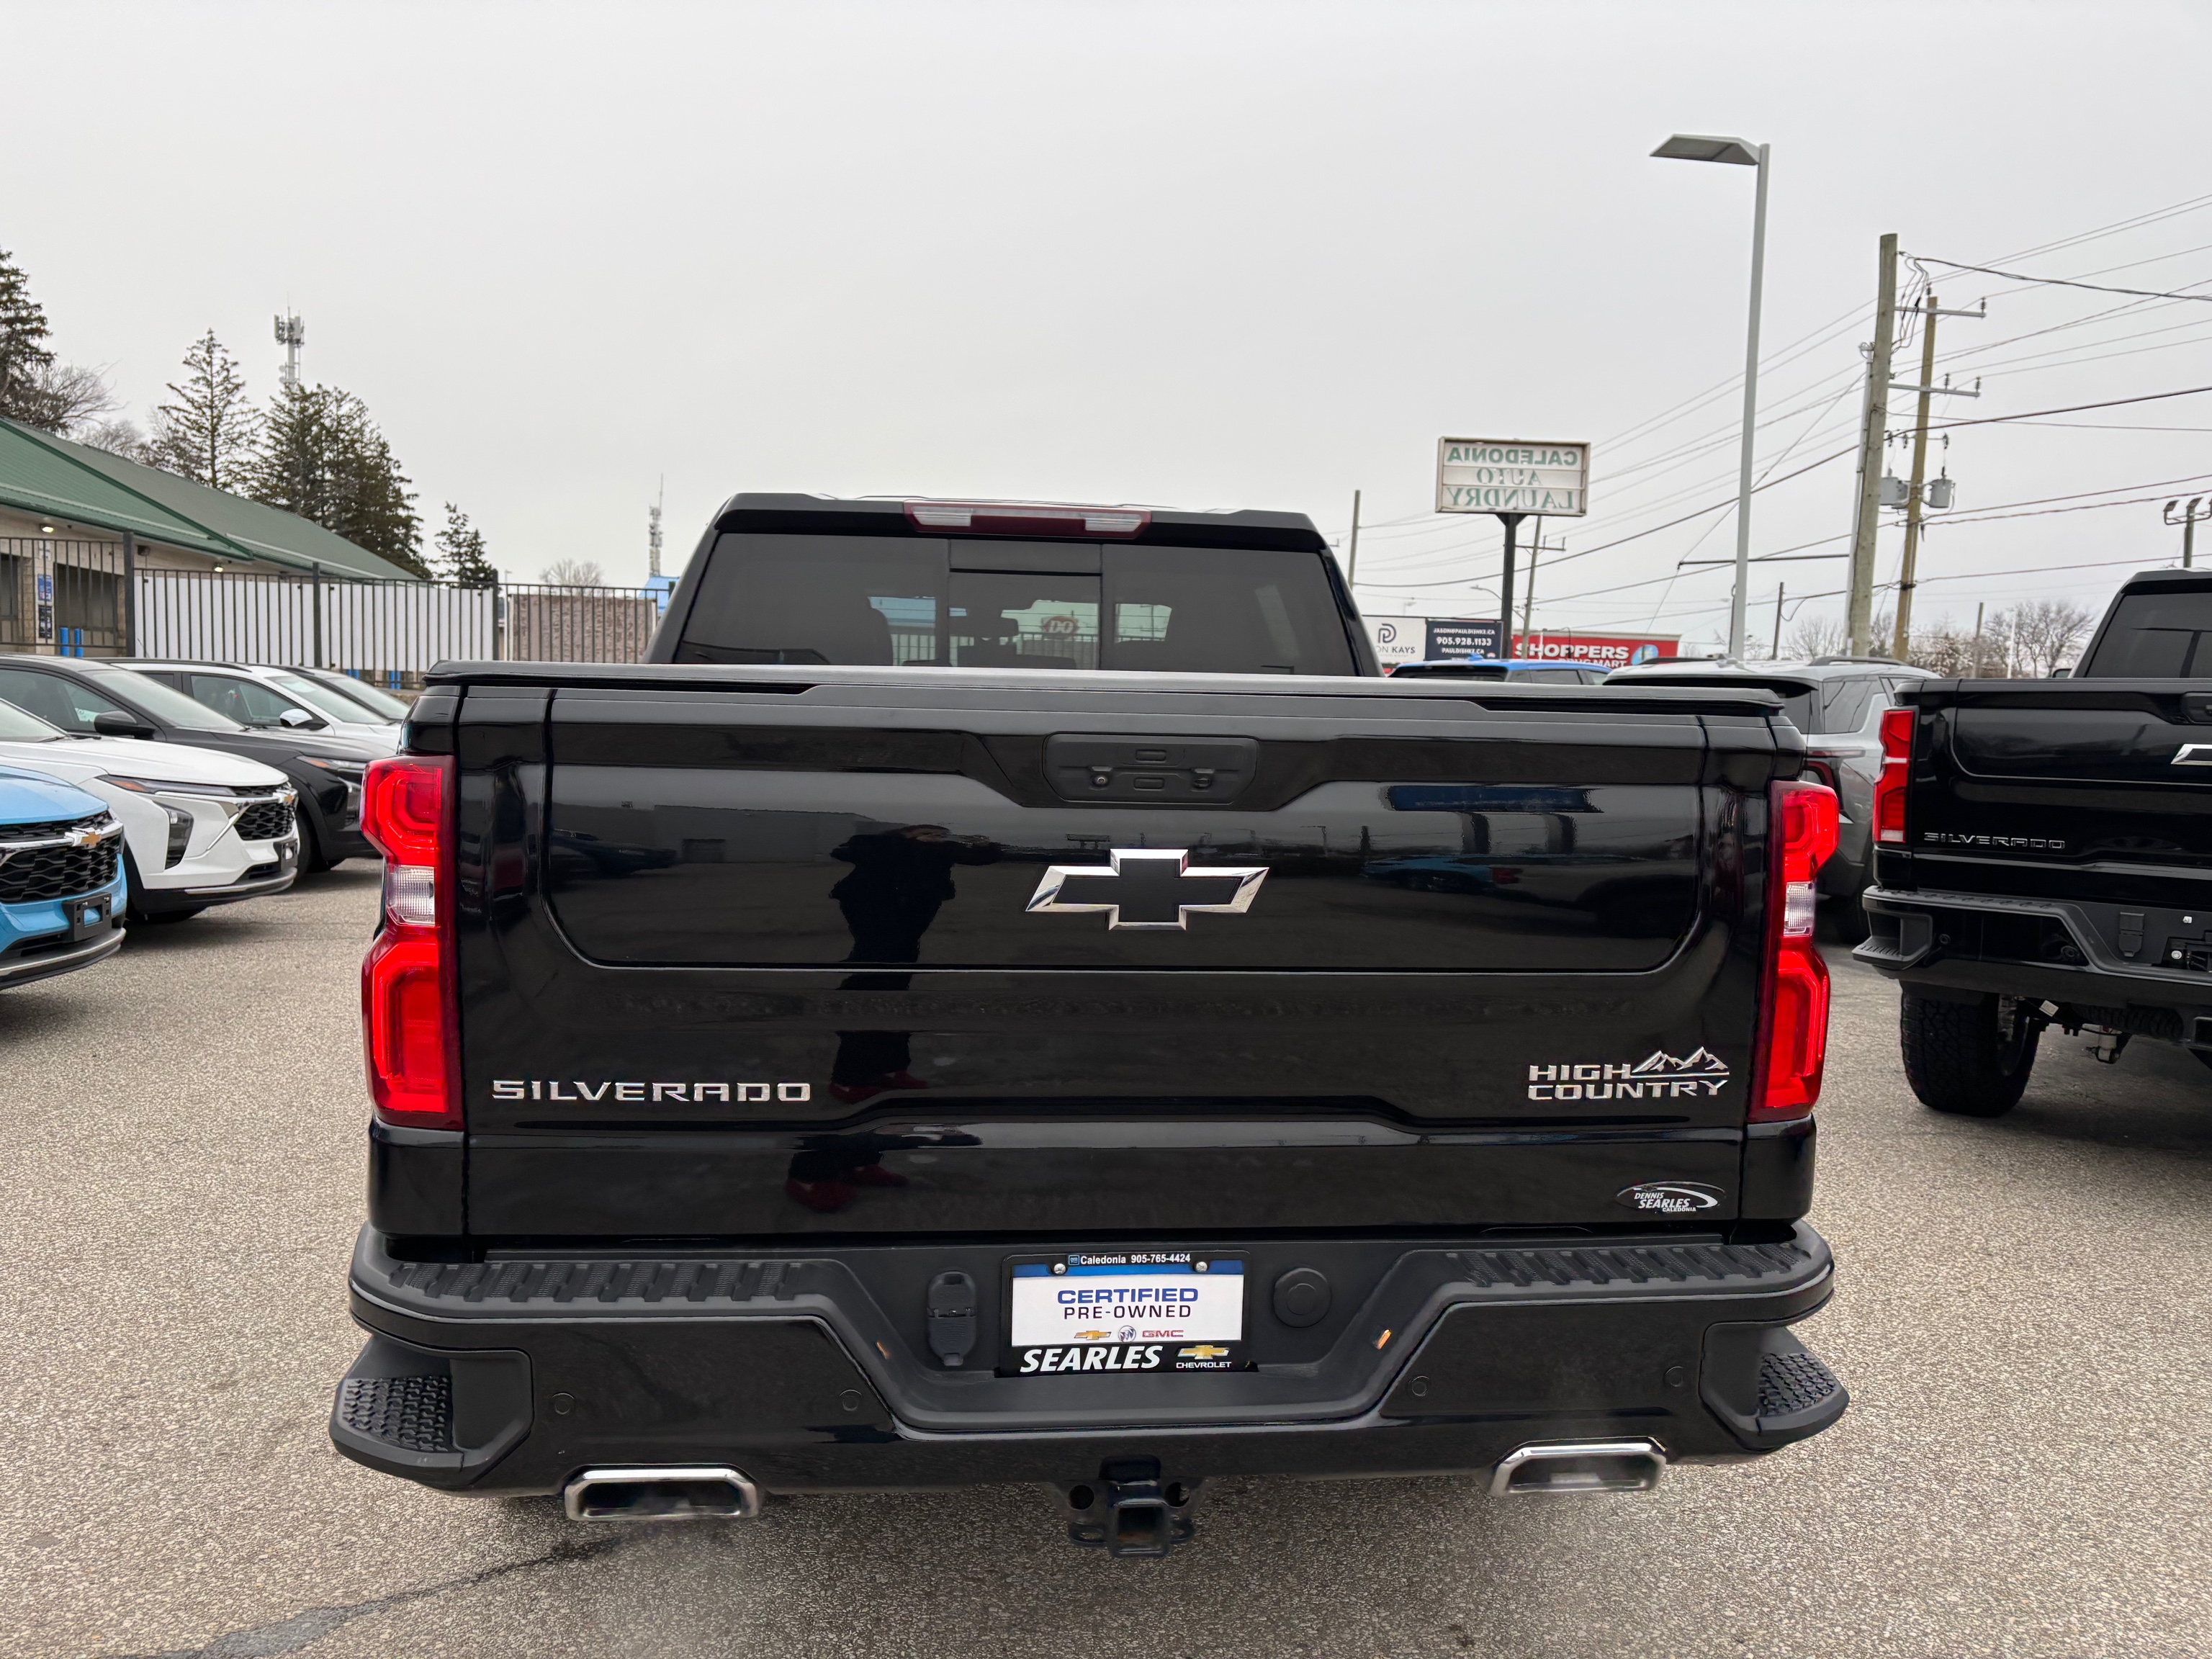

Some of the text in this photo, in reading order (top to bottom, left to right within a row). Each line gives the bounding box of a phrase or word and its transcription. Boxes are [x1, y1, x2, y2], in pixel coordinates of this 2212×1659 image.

[1436, 637, 1493, 647] 905.928.1133
[1515, 642, 1629, 659] SHOPPERS
[1592, 659, 1627, 668] MART
[1924, 832, 2065, 849] SILVERADO
[1529, 1064, 1632, 1081] HIGH
[492, 1080, 811, 1102] SILVERADO
[1528, 1080, 1728, 1100] COUNTRY
[1638, 1198, 1691, 1209] SEARLES
[1080, 1255, 1126, 1265] Caledonia
[1130, 1254, 1191, 1264] 905-765-4424
[1058, 1287, 1199, 1304] CERTIFIED
[1064, 1305, 1191, 1320] PRE-OWNED
[1020, 1345, 1164, 1372] SEARLES
